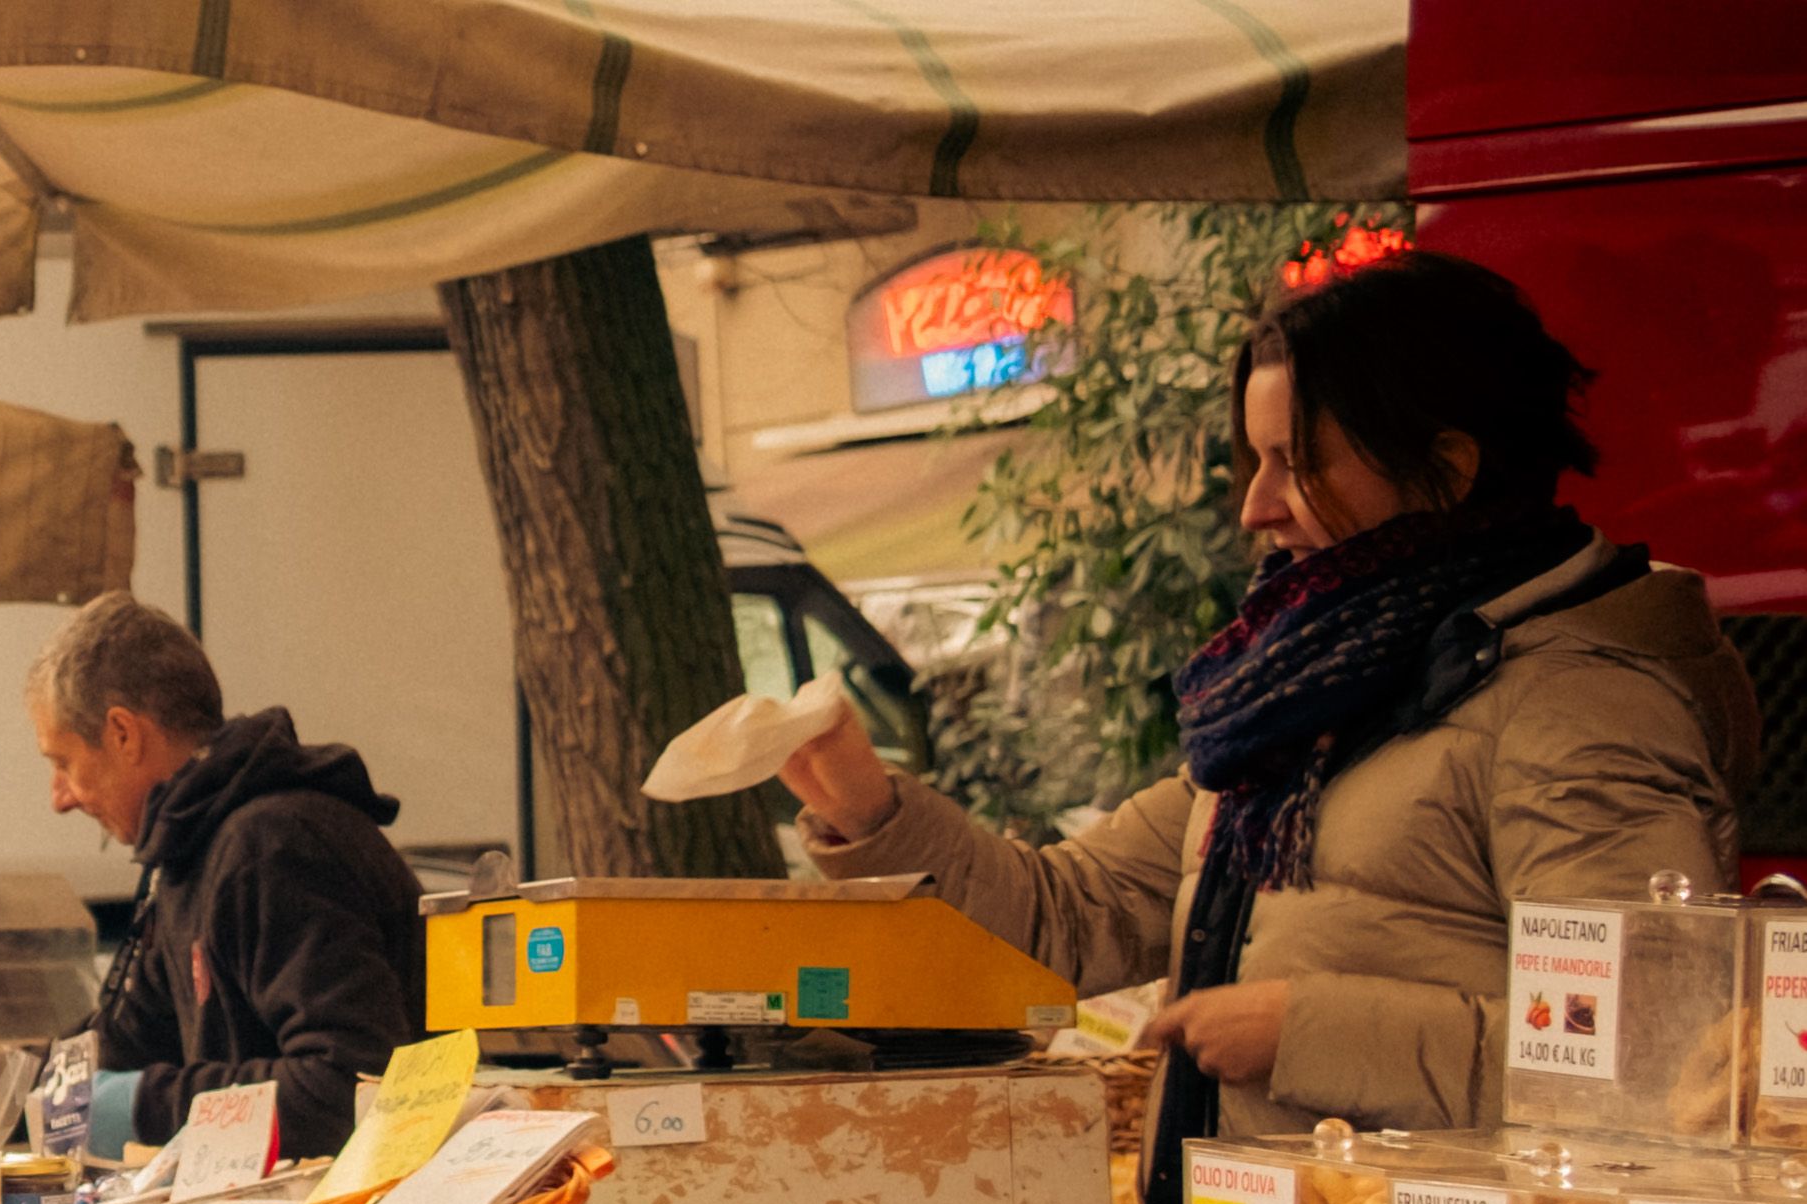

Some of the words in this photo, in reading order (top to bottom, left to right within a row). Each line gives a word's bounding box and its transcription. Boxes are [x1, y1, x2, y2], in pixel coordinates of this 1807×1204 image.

[1522, 916, 1606, 943] NAPOLETANO
[1515, 953, 1540, 972] PEPE
[1543, 956, 1549, 972] E
[1551, 957, 1611, 979] MANDORLE
[1519, 1040, 1549, 1064] 14,00
[1553, 1044, 1561, 1063] €
[1562, 1046, 1576, 1065] AL
[1580, 1048, 1595, 1067] KG
[1773, 1066, 1805, 1088] 14,00
[1193, 1164, 1221, 1188] OLIO
[1225, 1170, 1239, 1190] DI
[1241, 1172, 1276, 1196] OLIVA
